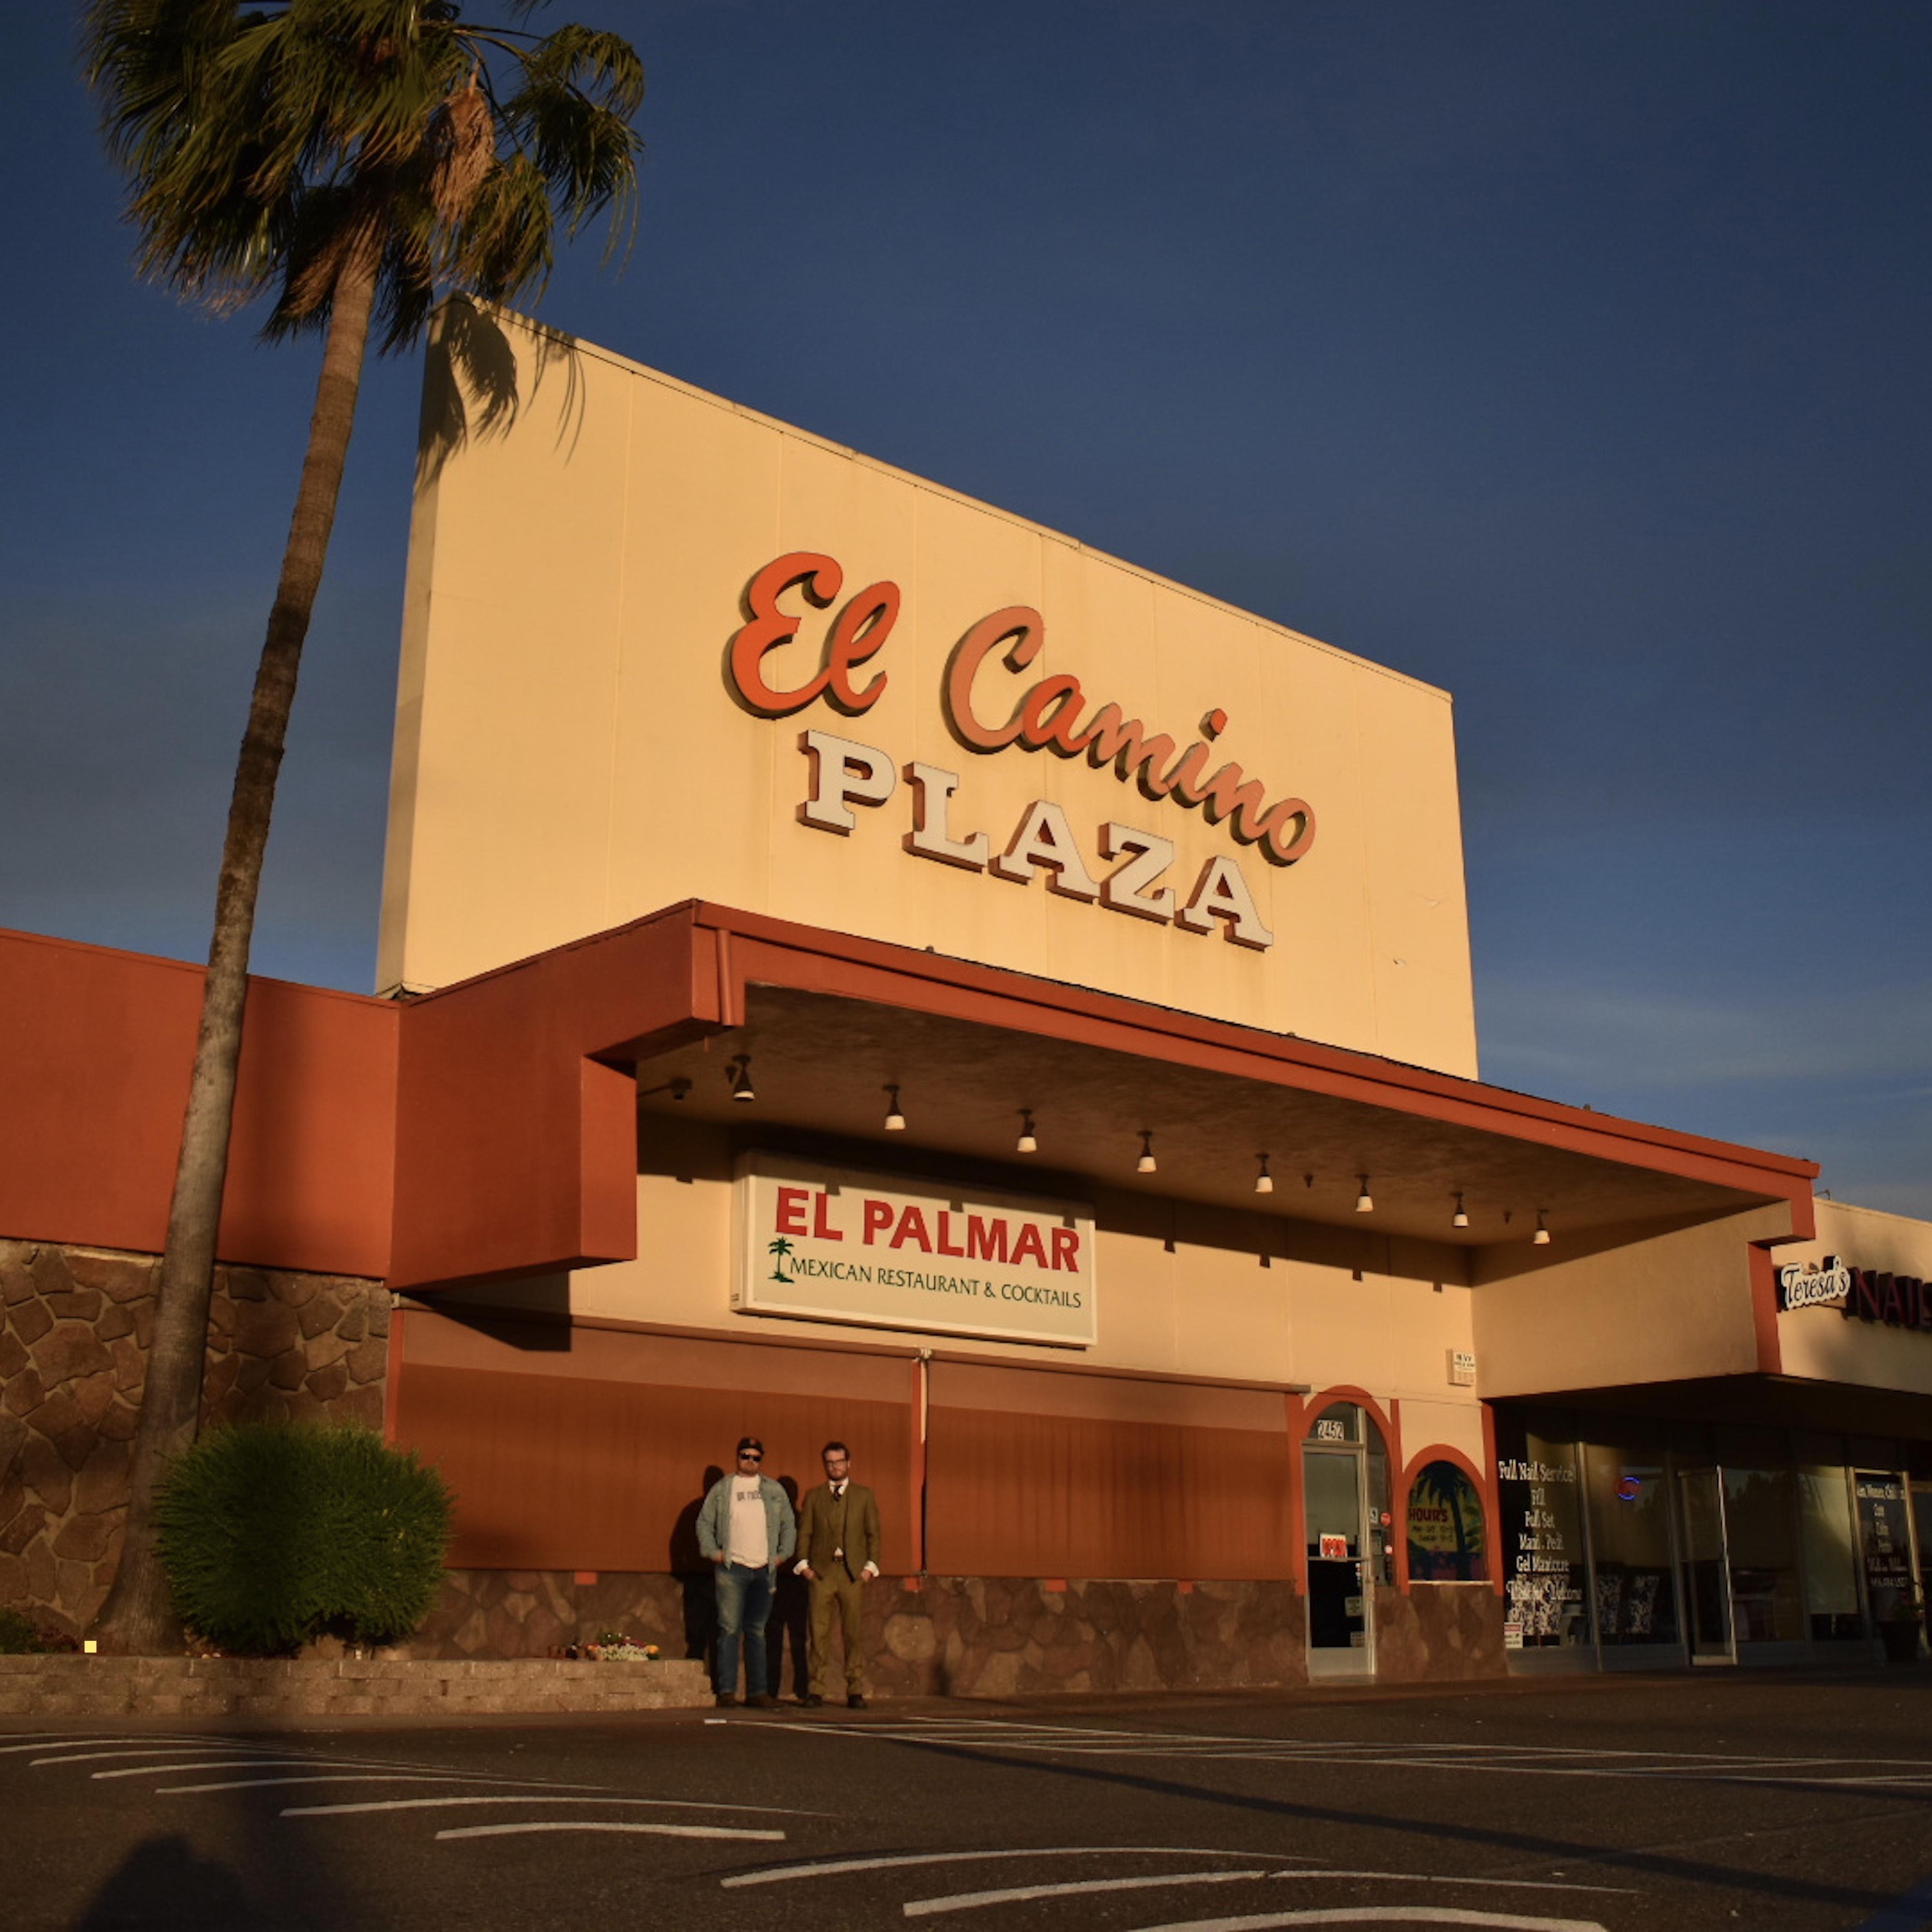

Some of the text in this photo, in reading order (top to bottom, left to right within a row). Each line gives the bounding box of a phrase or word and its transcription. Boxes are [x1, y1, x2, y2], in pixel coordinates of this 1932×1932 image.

[724, 552, 1316, 866] El Camino
[798, 729, 1274, 952] PLAZA
[775, 1186, 1080, 1274] EL PALMAR
[790, 1257, 1082, 1308] MEXICAN RESTAURANT & COCKTAILS
[1782, 1257, 1849, 1307] Teresa's
[1318, 1421, 1343, 1438] 2452
[1498, 1459, 1518, 1480] Full
[1408, 1508, 1448, 1523] HOURS
[1516, 1554, 1531, 1572] Gel
